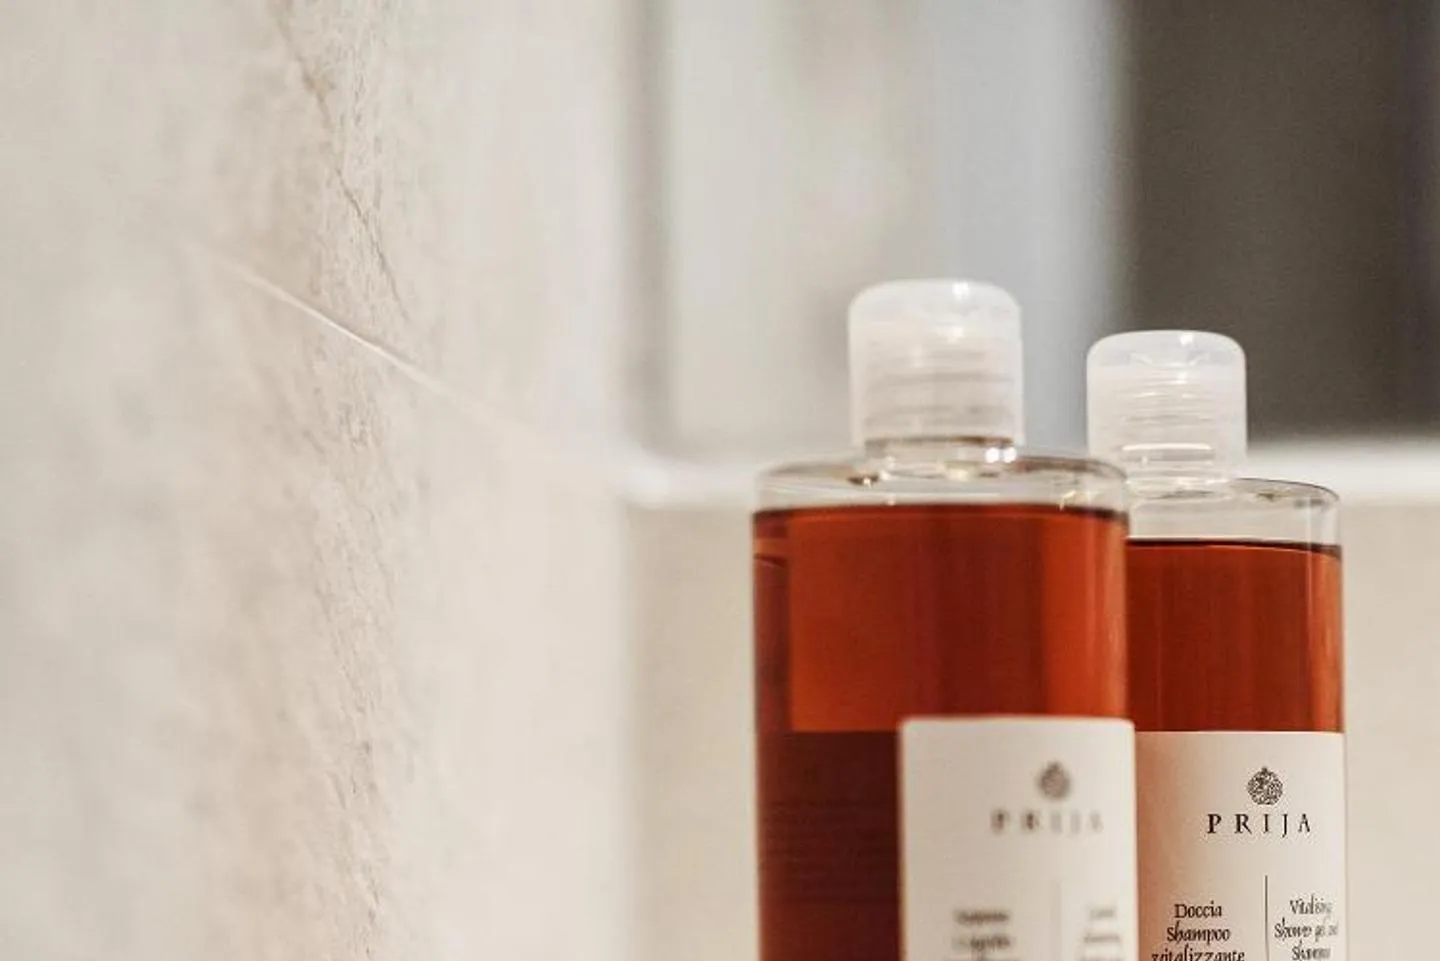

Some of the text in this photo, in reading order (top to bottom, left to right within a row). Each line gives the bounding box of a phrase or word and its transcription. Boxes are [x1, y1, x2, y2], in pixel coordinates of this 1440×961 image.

[1207, 814, 1311, 837] PRIJA
[1174, 900, 1222, 918] Doccia
[1166, 920, 1231, 945] Shampoo
